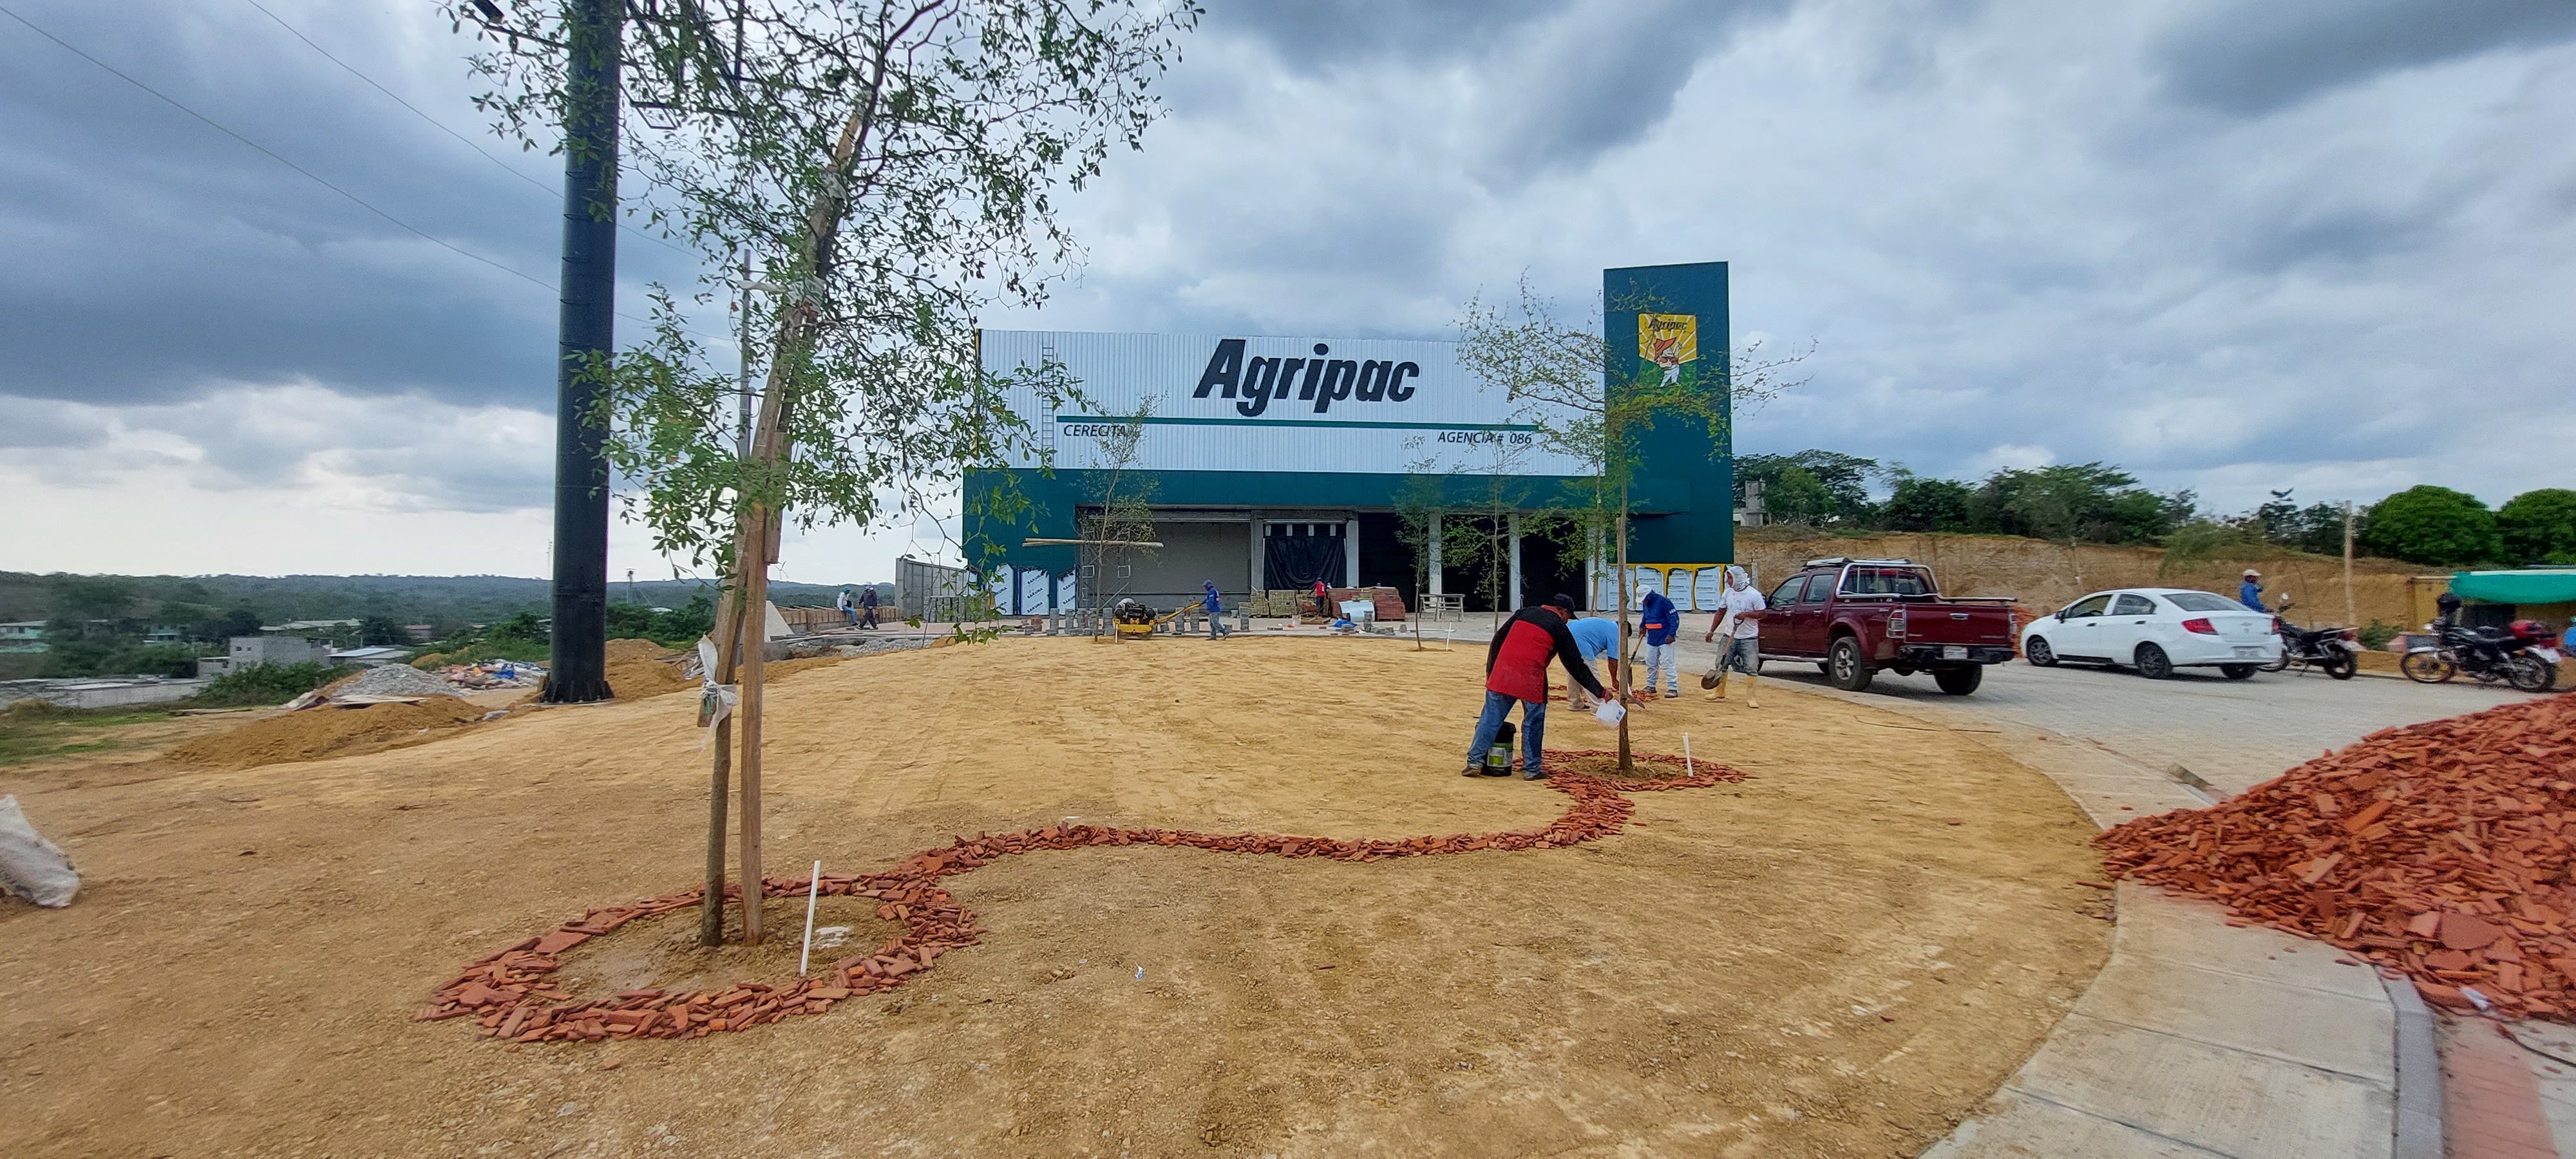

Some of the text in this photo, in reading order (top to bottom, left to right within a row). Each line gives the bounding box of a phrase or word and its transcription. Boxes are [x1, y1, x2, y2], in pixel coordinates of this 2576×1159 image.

[1192, 339, 1420, 417] Agripac
[1064, 424, 1126, 437] CERECITA
[1437, 431, 1493, 444] AGENCIA
[1510, 433, 1532, 444] 086
